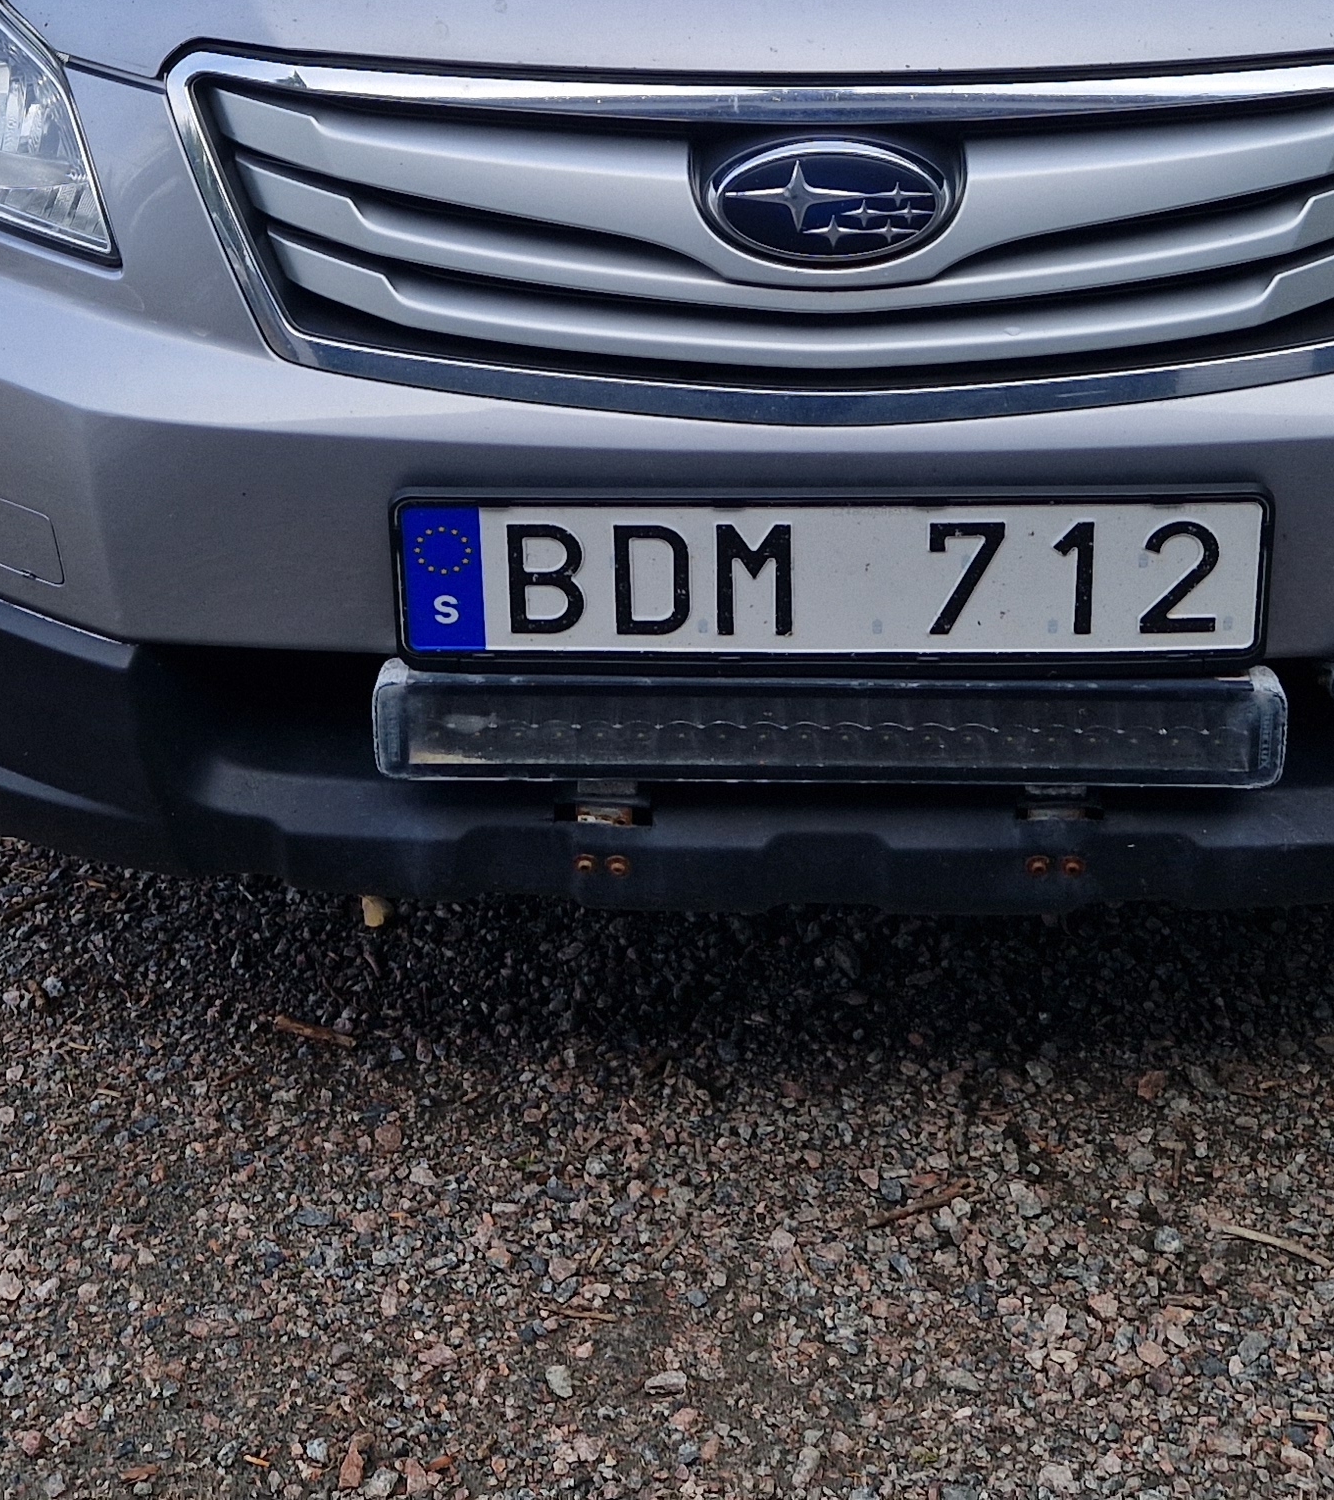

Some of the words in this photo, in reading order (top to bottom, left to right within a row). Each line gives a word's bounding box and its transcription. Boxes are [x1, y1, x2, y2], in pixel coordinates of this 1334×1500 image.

[433, 594, 460, 625] S
[505, 523, 793, 636] BDM
[928, 521, 1220, 635] 712
